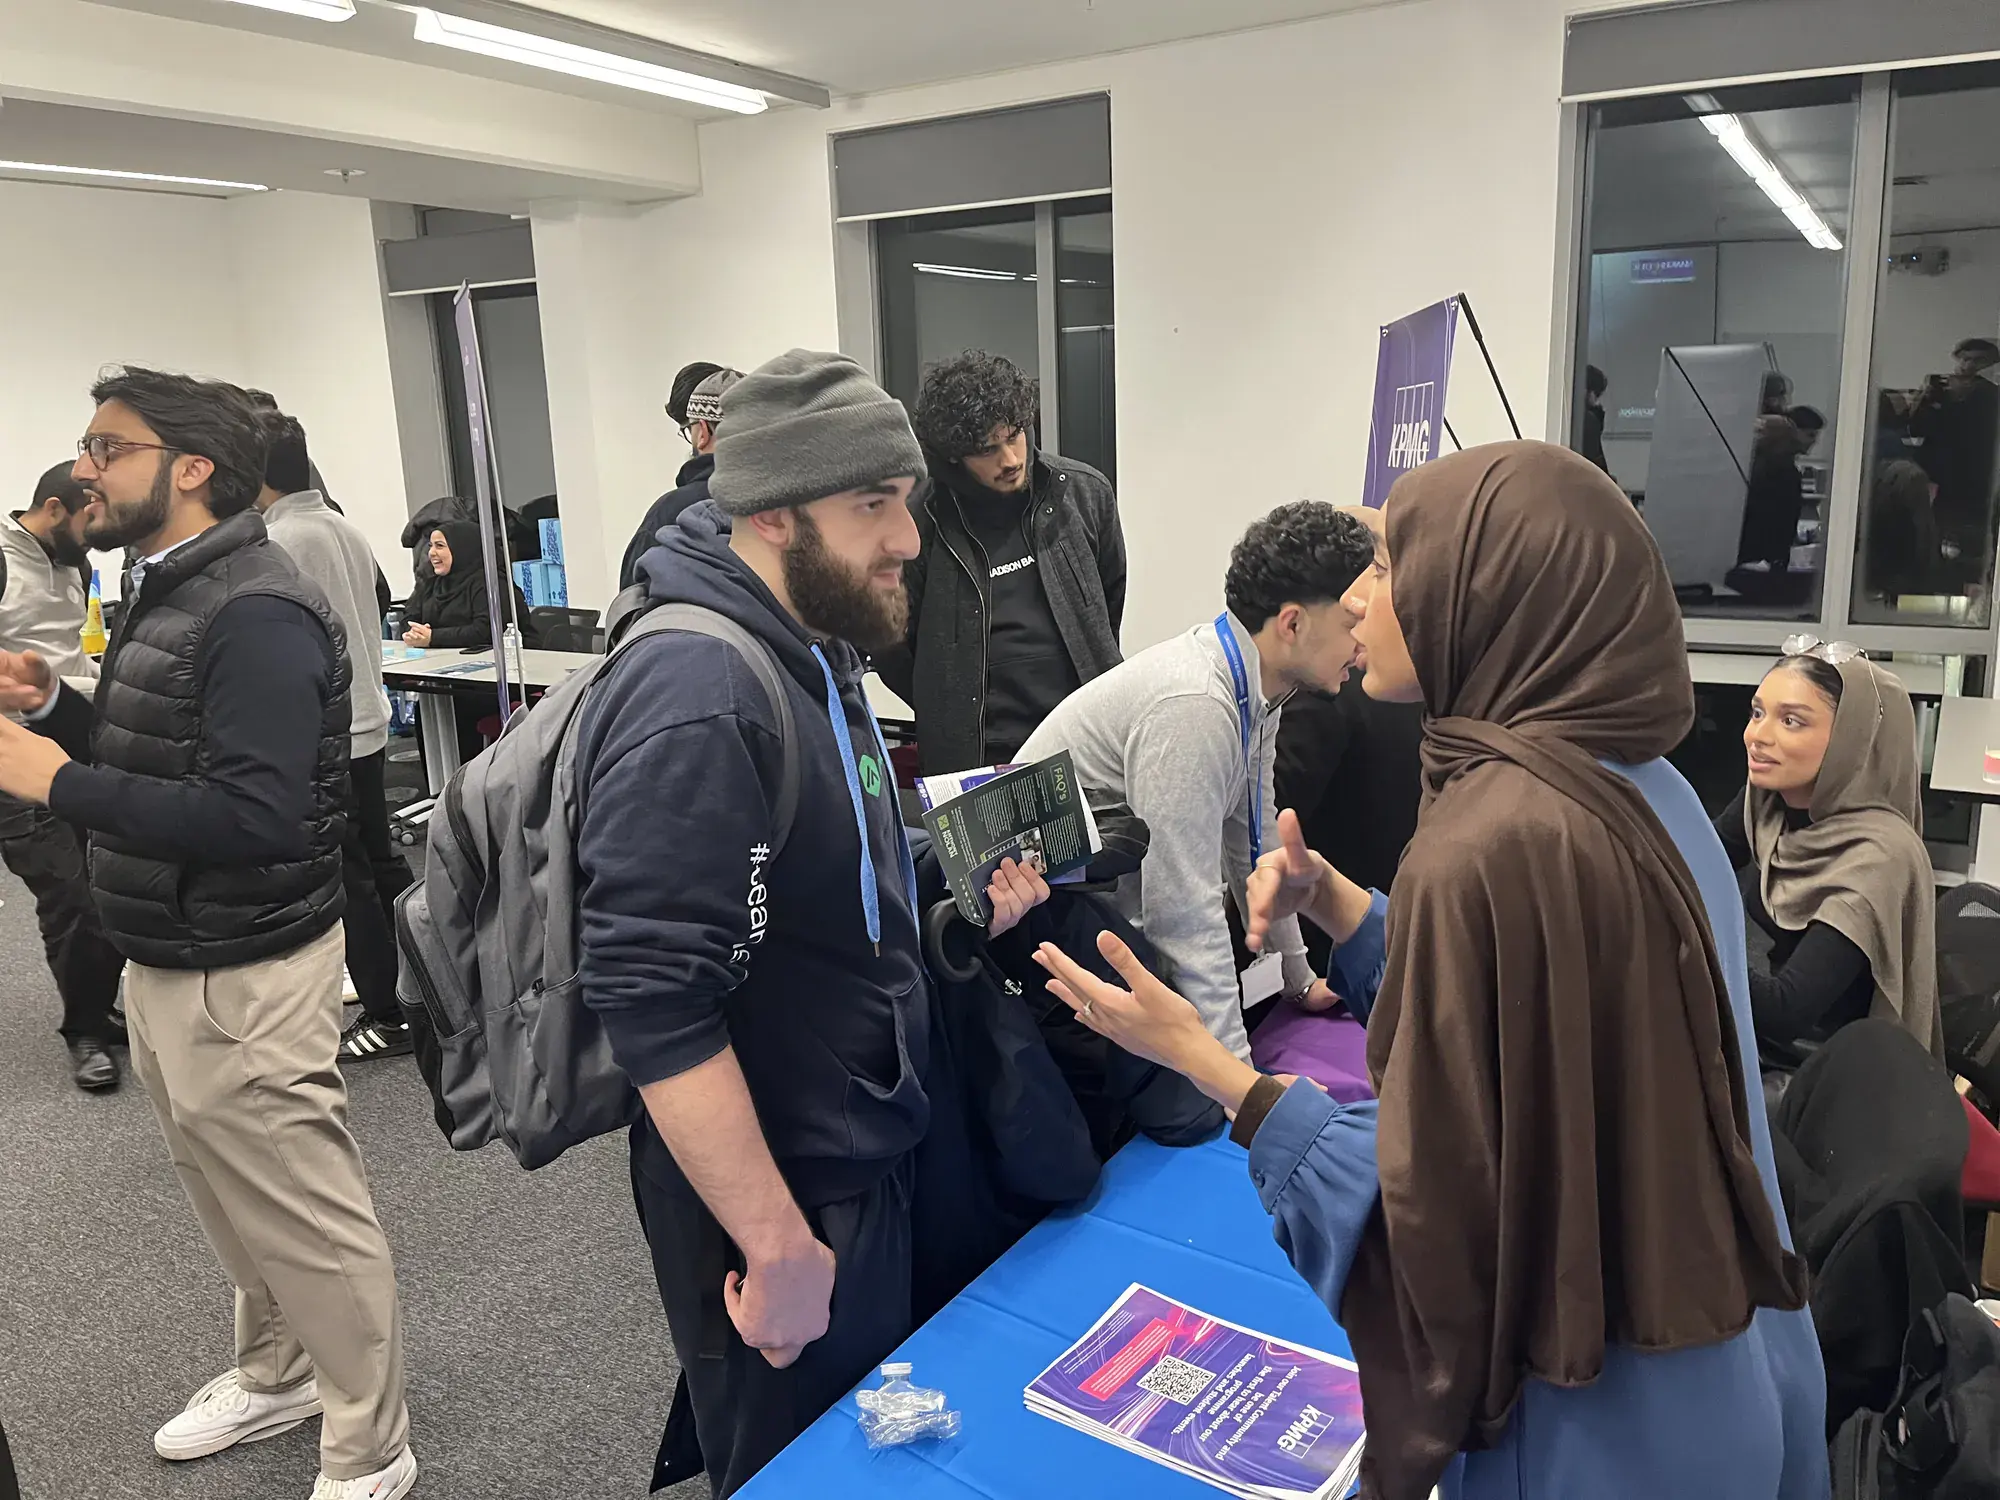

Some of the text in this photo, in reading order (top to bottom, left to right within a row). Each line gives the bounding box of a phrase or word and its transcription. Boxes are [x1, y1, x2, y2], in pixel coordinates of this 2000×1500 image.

[1388, 420, 1429, 468] KPMG
[1054, 767, 1067, 801] FAQ's
[942, 830, 956, 859] NOLAN
[1171, 1353, 1255, 1435] launches and student events.
[1199, 1365, 1273, 1442] the first to hear about our
[1207, 1379, 1243, 1415] programme
[1215, 1365, 1301, 1461] Join our Talent Community and
[1233, 1391, 1265, 1423] be one of
[1277, 1404, 1321, 1451] KPMG
